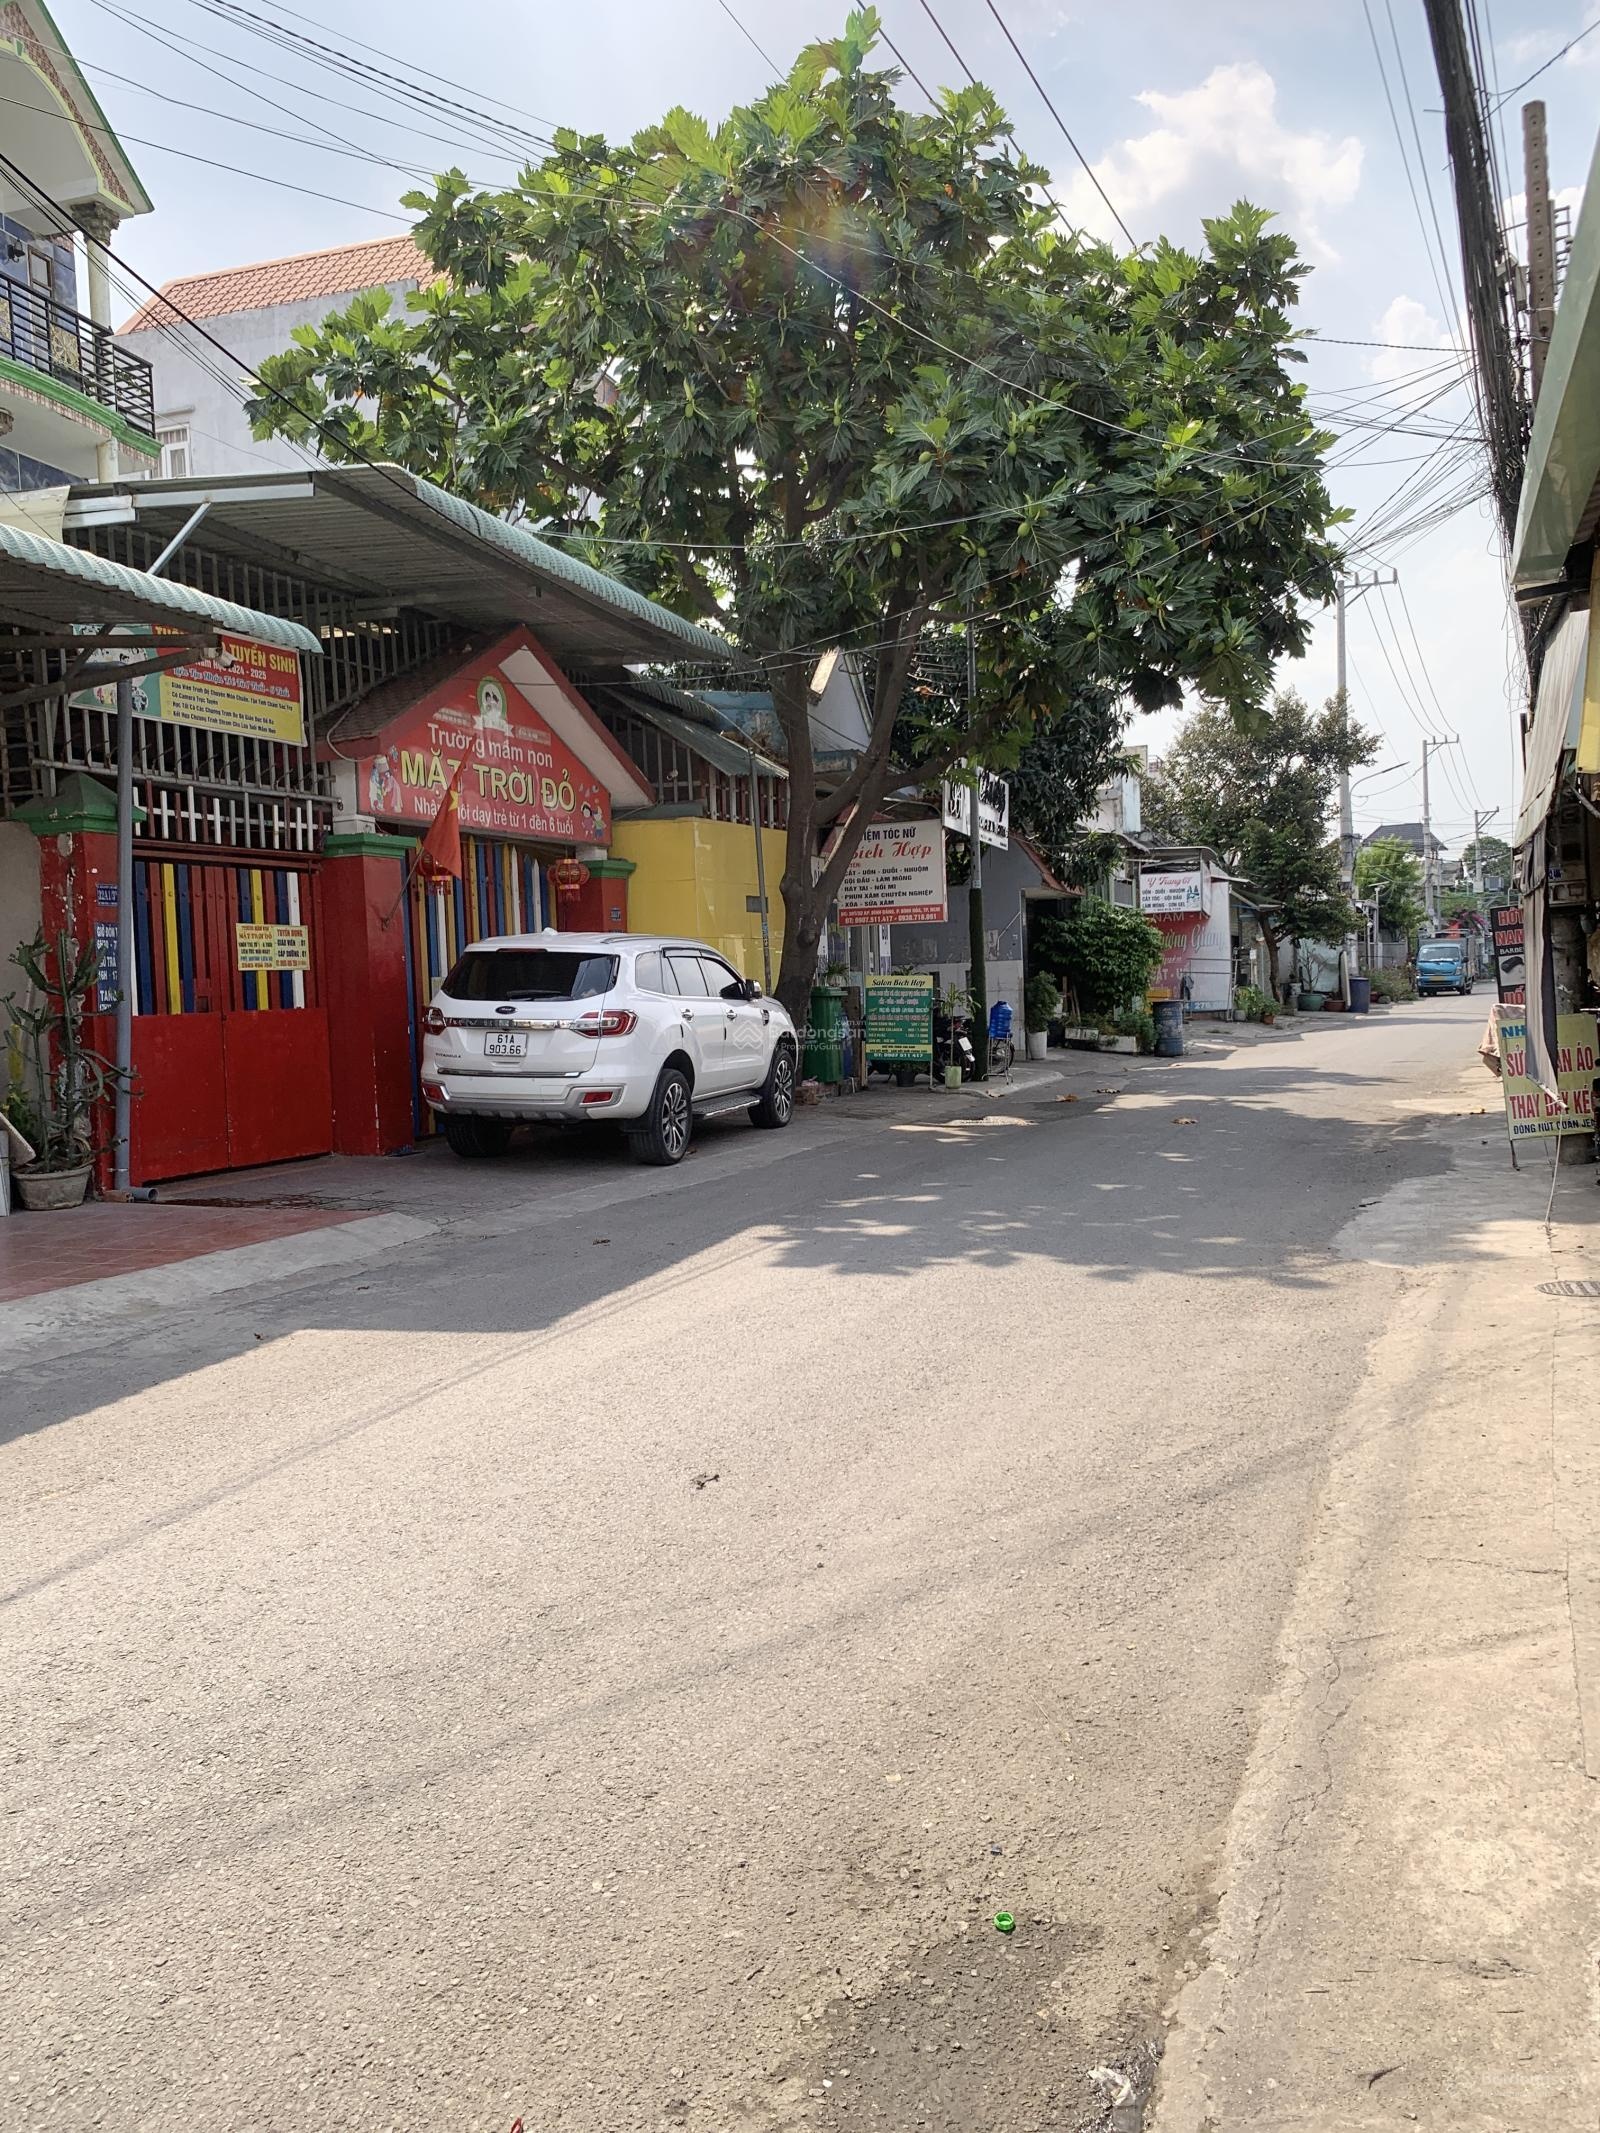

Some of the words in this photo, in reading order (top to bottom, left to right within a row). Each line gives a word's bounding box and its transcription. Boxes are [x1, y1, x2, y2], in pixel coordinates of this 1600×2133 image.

[229, 643, 267, 668] TUYỂN
[269, 653, 297, 675] SINH
[250, 668, 267, 680] 2025
[527, 751, 553, 769] non
[472, 763, 535, 806] TRỜI
[540, 767, 577, 814] ĐỎ
[414, 796, 443, 818] Nhậ
[472, 807, 491, 827] dạy
[493, 808, 508, 825] trẻ
[521, 814, 526, 827] 1
[549, 817, 555, 832] 6
[864, 829, 880, 842] IỆM
[883, 827, 900, 840] TÓC
[902, 826, 917, 839] NỮ
[1500, 946, 1525, 955] BARBE
[497, 1034, 515, 1044] 61A
[1501, 1025, 1527, 1038] NH
[489, 1044, 522, 1055] 903.66
[1506, 1044, 1526, 1077] SỬ
[1576, 1041, 1594, 1072] ÁO
[1509, 1093, 1540, 1120] THAY
[1573, 1084, 1596, 1115] KÉ
